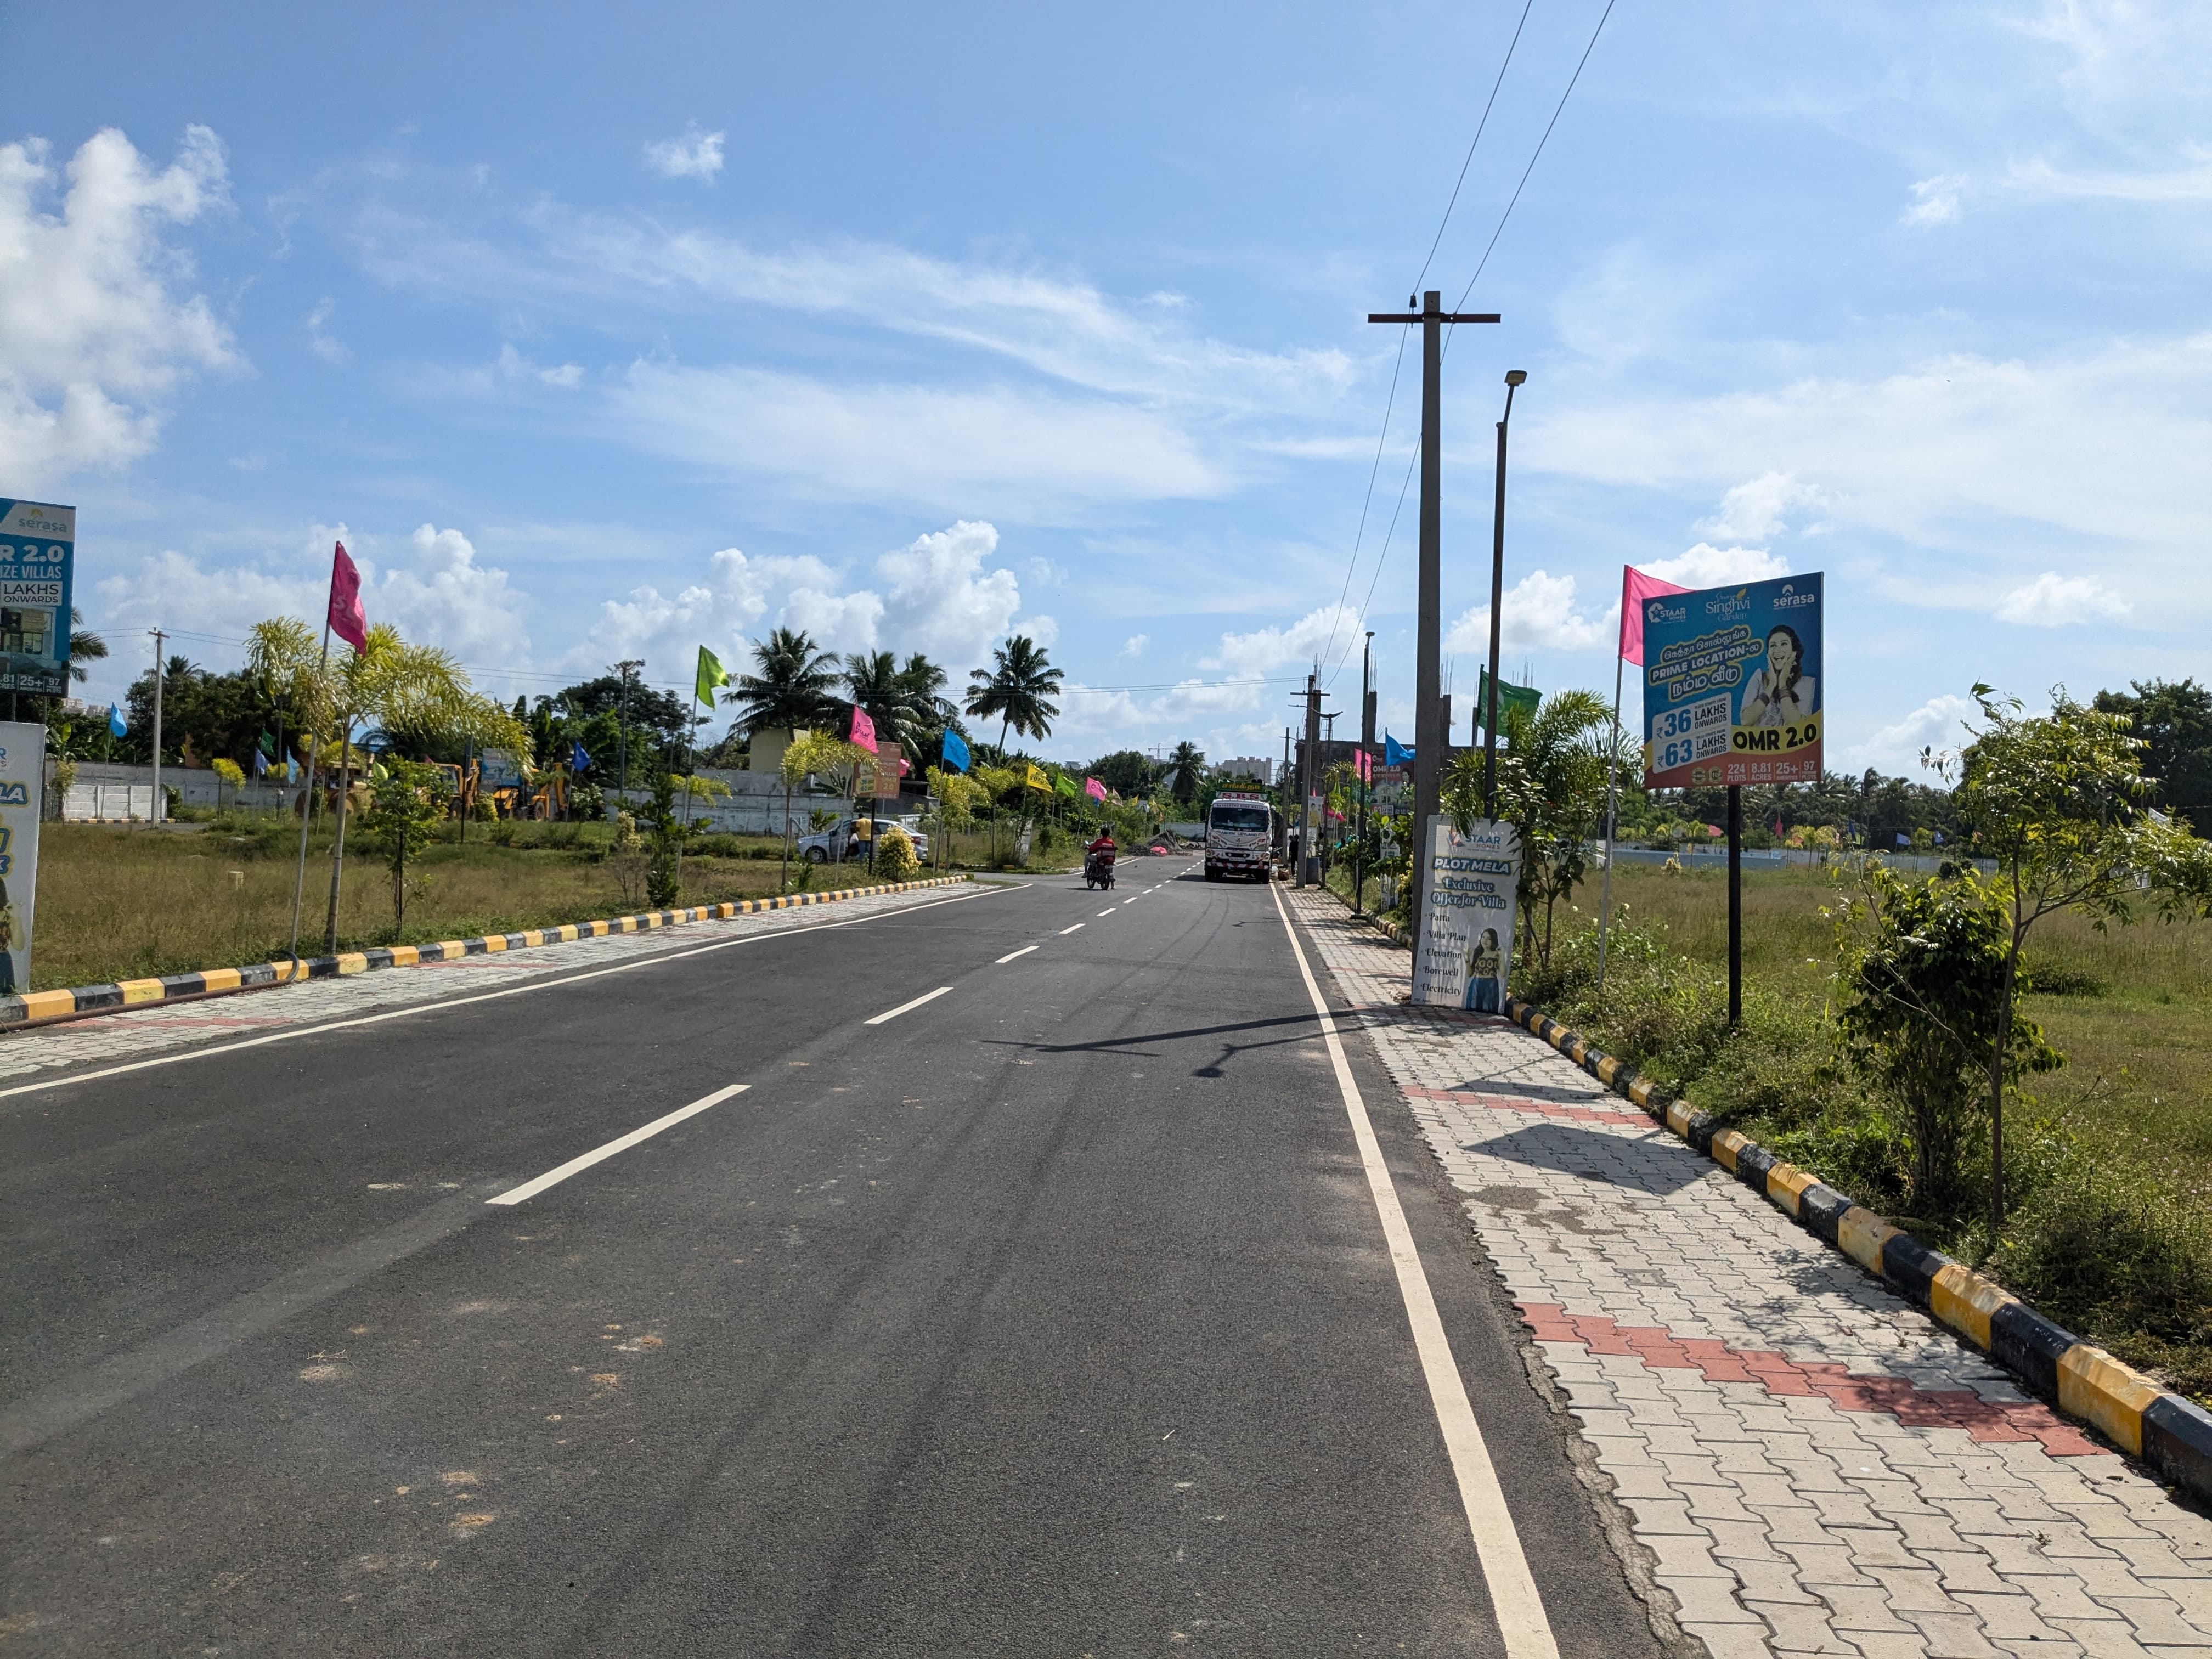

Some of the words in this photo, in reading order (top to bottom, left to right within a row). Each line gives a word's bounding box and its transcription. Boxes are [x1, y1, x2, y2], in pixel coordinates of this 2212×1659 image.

[18, 518, 67, 532] serasa
[23, 545, 65, 562] 2.0
[22, 566, 62, 579] VILLAS
[4, 584, 59, 595] LAKHS
[1706, 597, 1750, 615] Singhvi
[1773, 593, 1814, 607] serasa
[1660, 607, 1686, 618] STAAR
[1653, 662, 1688, 680] PRIME
[20, 675, 43, 686] 25+
[49, 678, 60, 686] 97
[1673, 676, 1707, 697] நம்ம
[1712, 665, 1737, 683] வீடு
[1695, 703, 1726, 721] LAKHS
[1695, 714, 1727, 729] ONWARDS
[1696, 734, 1726, 751] LAKHS
[1733, 729, 1780, 751] OMR
[1786, 724, 1817, 748] 2.0
[1696, 744, 1726, 759] ONWARDS
[1728, 764, 1745, 774] 224
[1751, 763, 1771, 774] 8.81
[1776, 762, 1798, 774] 25+
[1804, 761, 1815, 771] 97
[1465, 834, 1500, 844] STAAR
[1434, 858, 1469, 870] PLOT
[1471, 860, 1509, 873] MELA
[1443, 878, 1493, 891] Exclusive
[1432, 893, 1459, 906] Offer
[1459, 894, 1476, 907] for
[1479, 895, 1505, 909] Villa
[1429, 912, 1450, 922] Patta
[1427, 930, 1446, 940] Villa
[1448, 932, 1466, 942] Plan
[1425, 948, 1462, 959] Elevation
[1423, 966, 1459, 977] Borewell
[1420, 983, 1462, 996] Electricity
